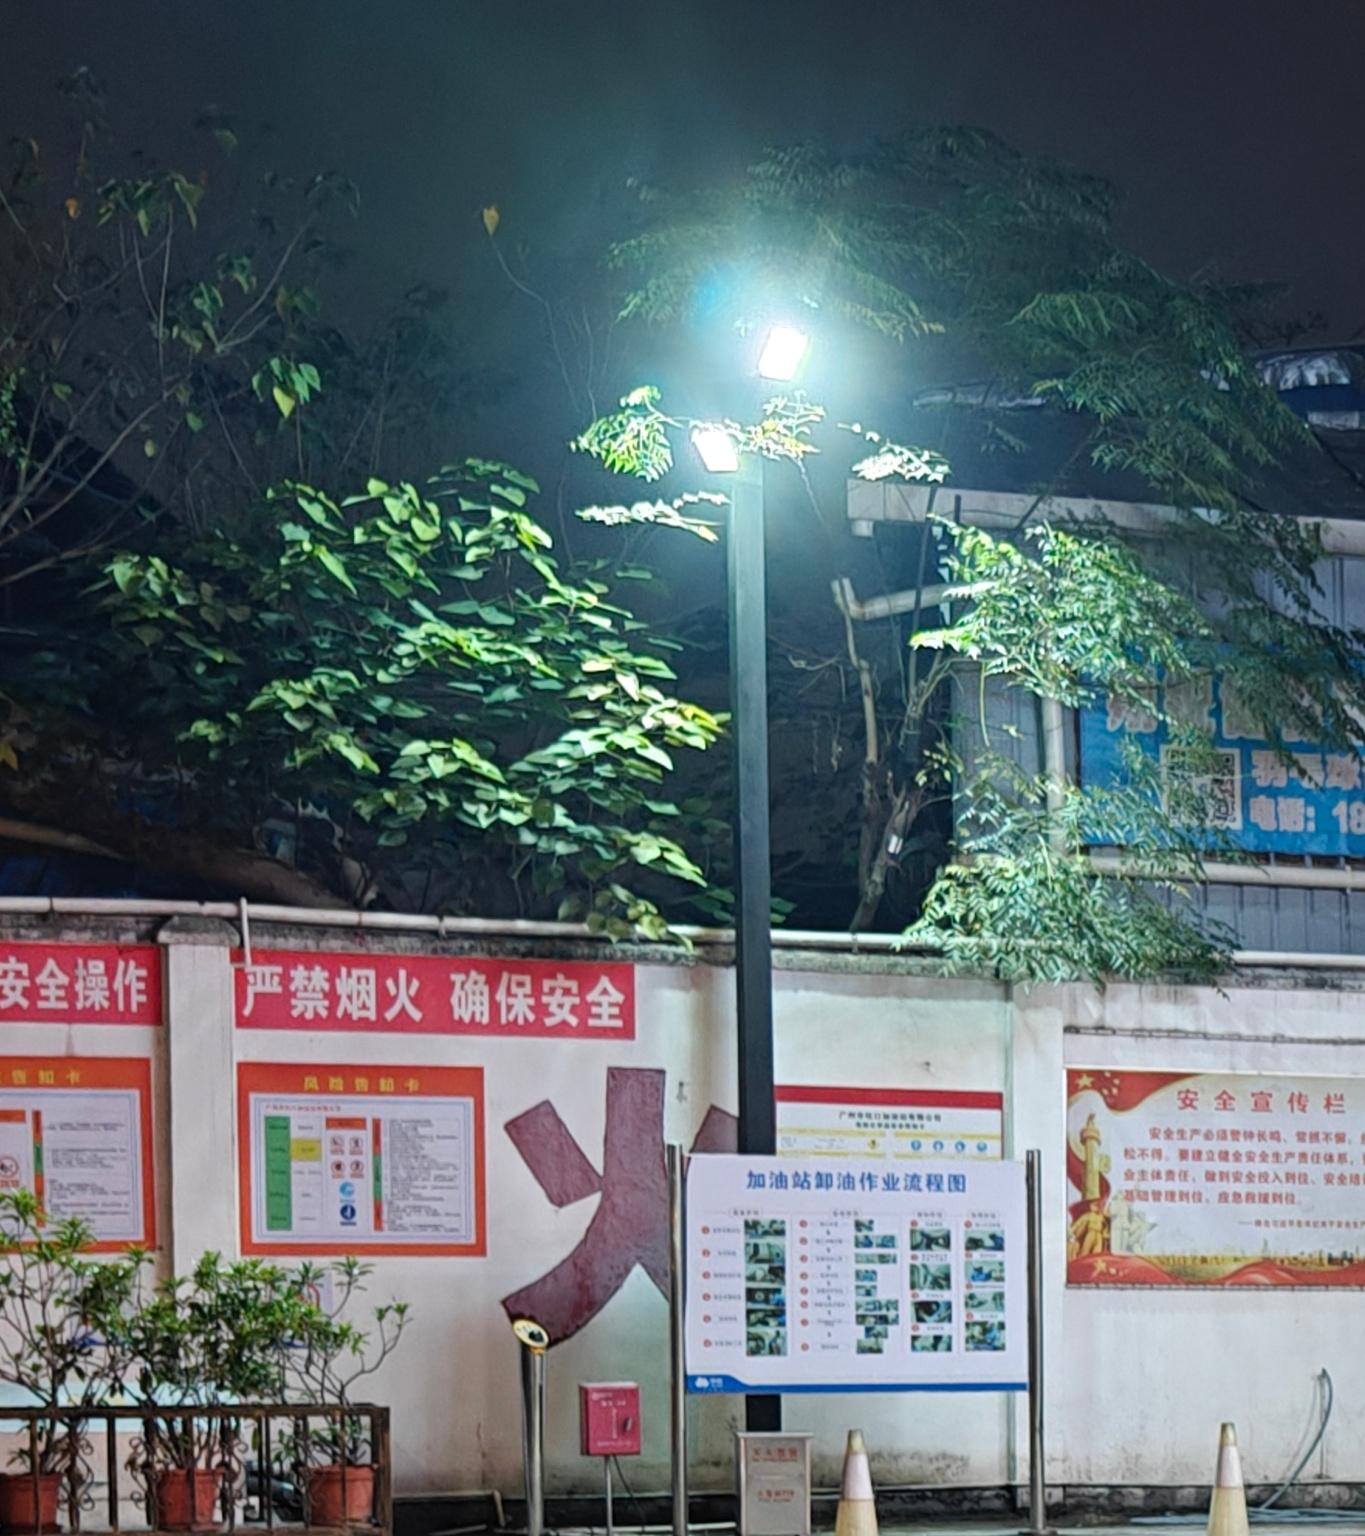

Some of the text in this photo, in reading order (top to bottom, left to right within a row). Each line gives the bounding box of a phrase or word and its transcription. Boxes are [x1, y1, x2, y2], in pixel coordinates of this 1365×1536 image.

[0, 957, 148, 1013] 安全操作
[243, 963, 626, 1029] 严禁烟火 确保安全
[1177, 1089, 1346, 1115] 安全宣传栏
[746, 1170, 967, 1193] 加油站卸油作业流程图
